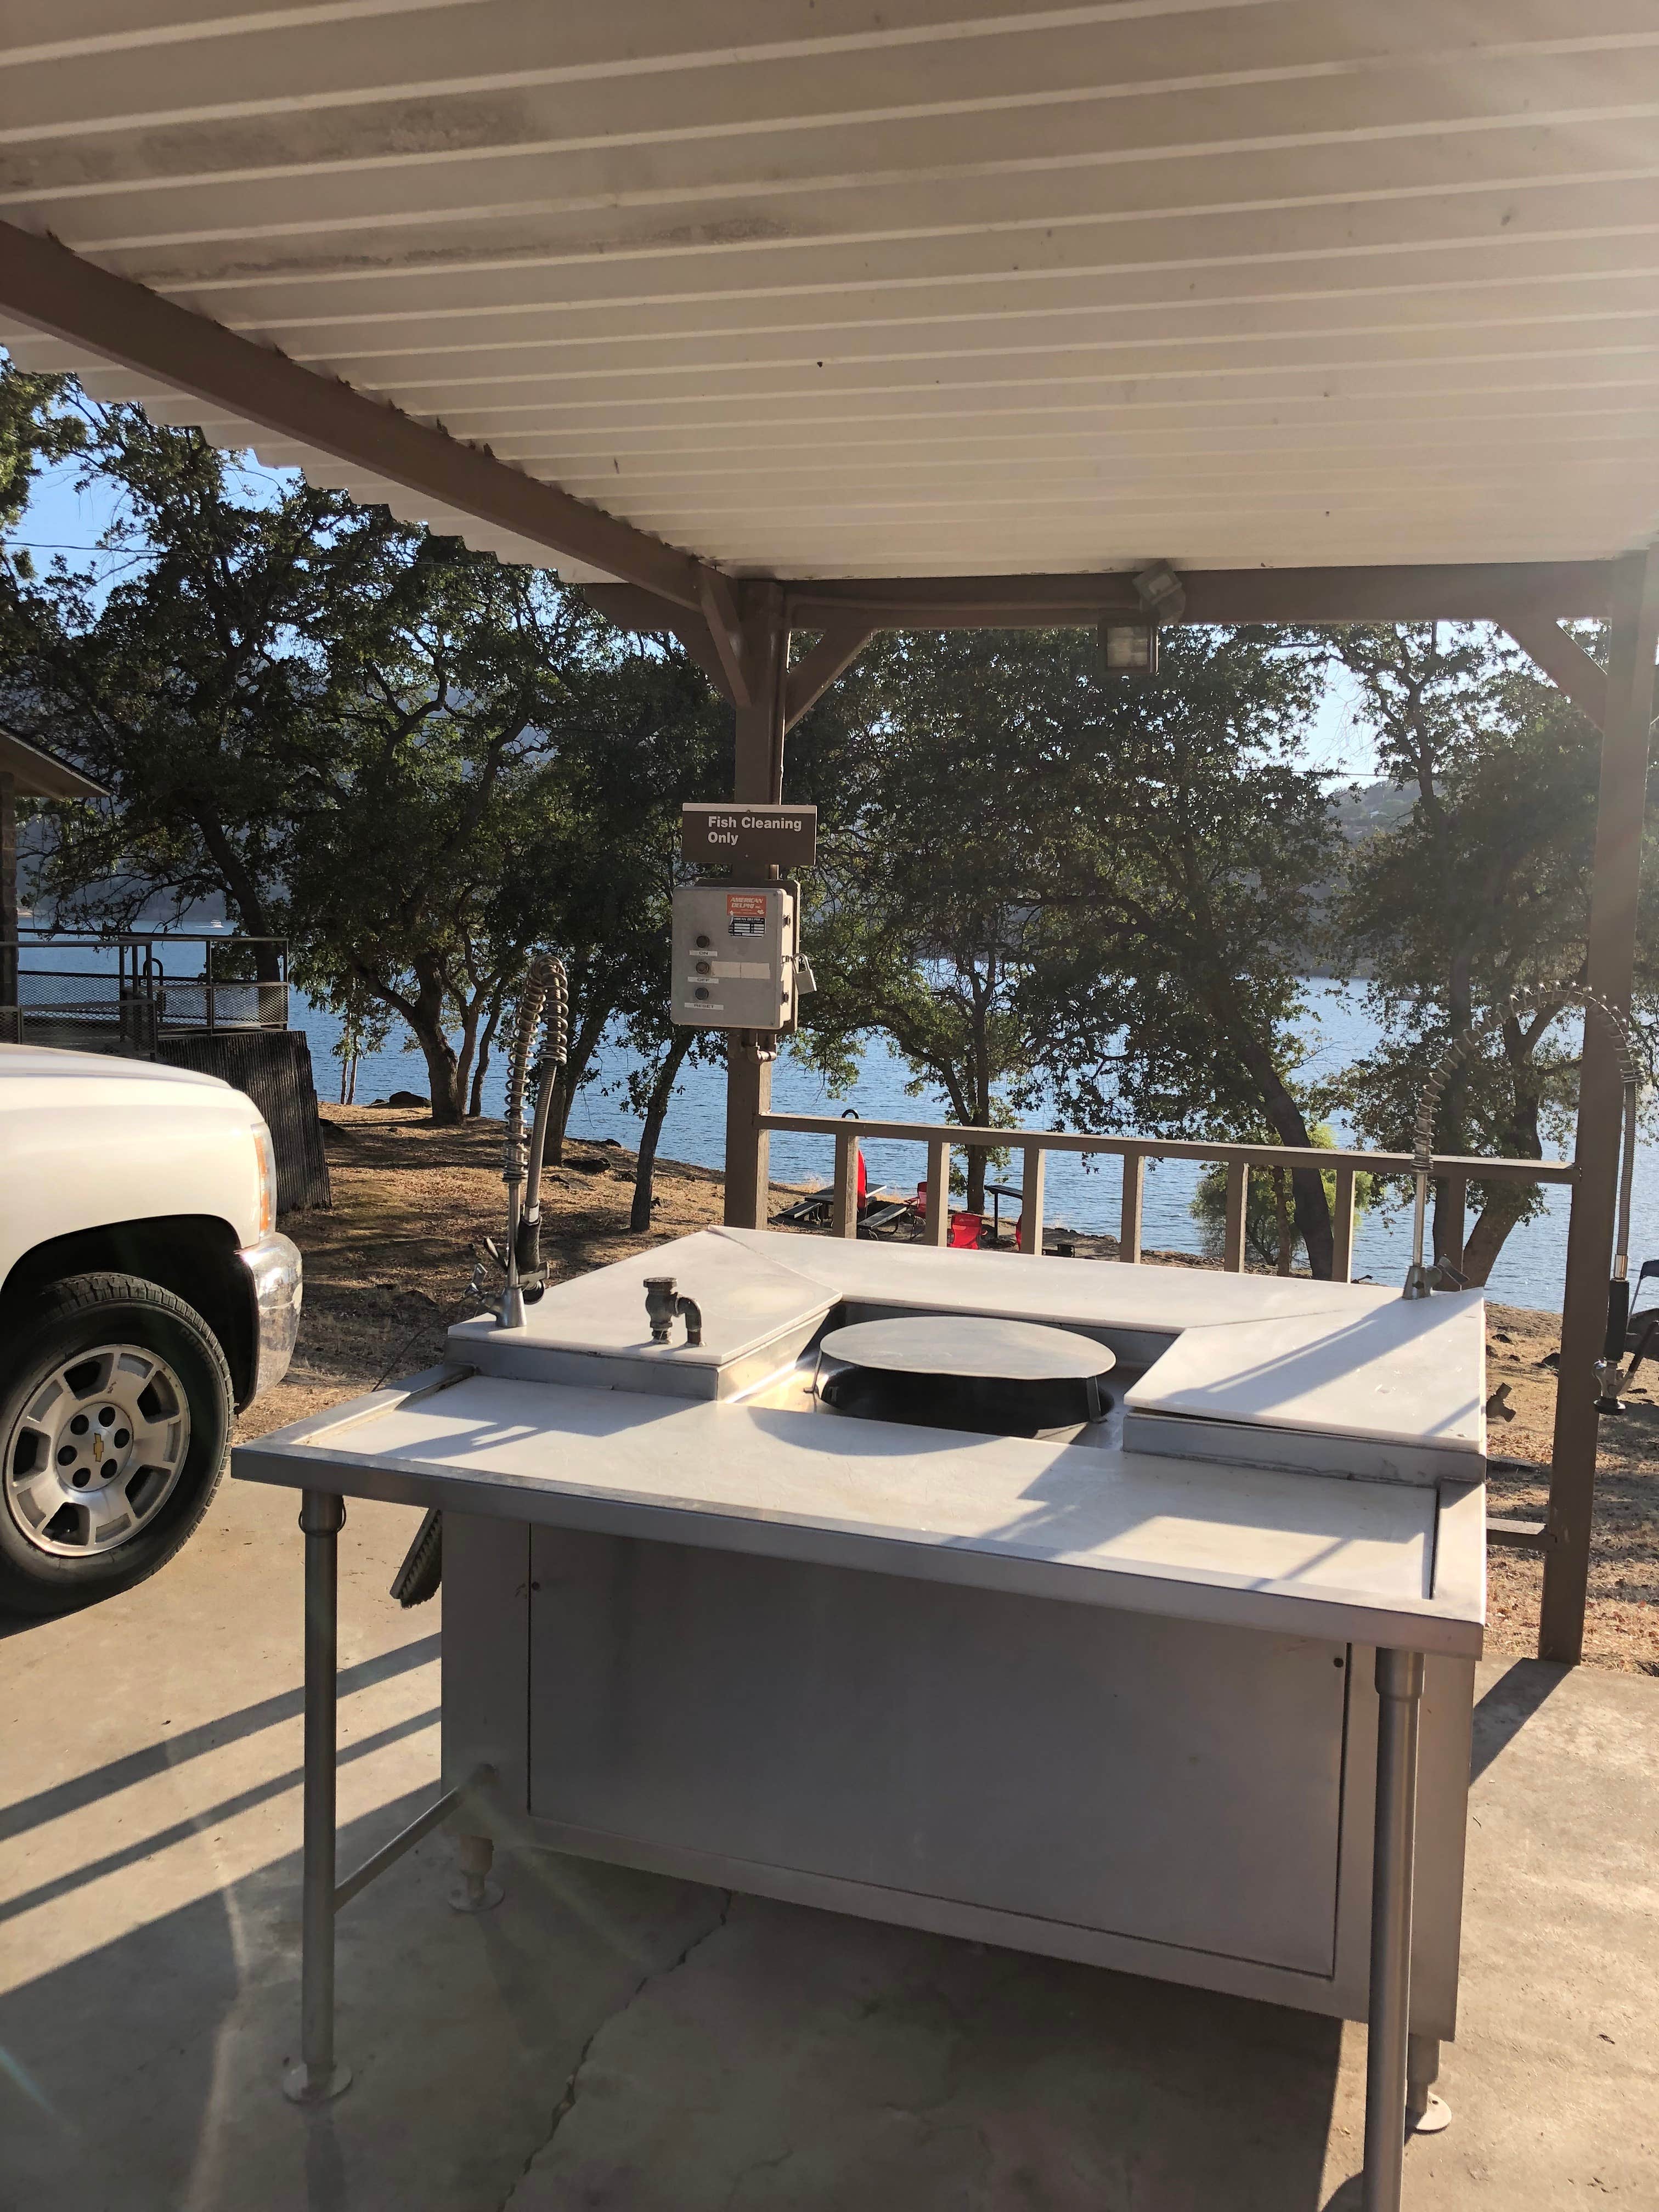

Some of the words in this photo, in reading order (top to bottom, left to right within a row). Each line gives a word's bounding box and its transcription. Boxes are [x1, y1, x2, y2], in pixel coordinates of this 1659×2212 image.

[708, 816, 737, 828] Fish
[741, 817, 802, 832] Cleaning
[708, 832, 738, 846] Only
